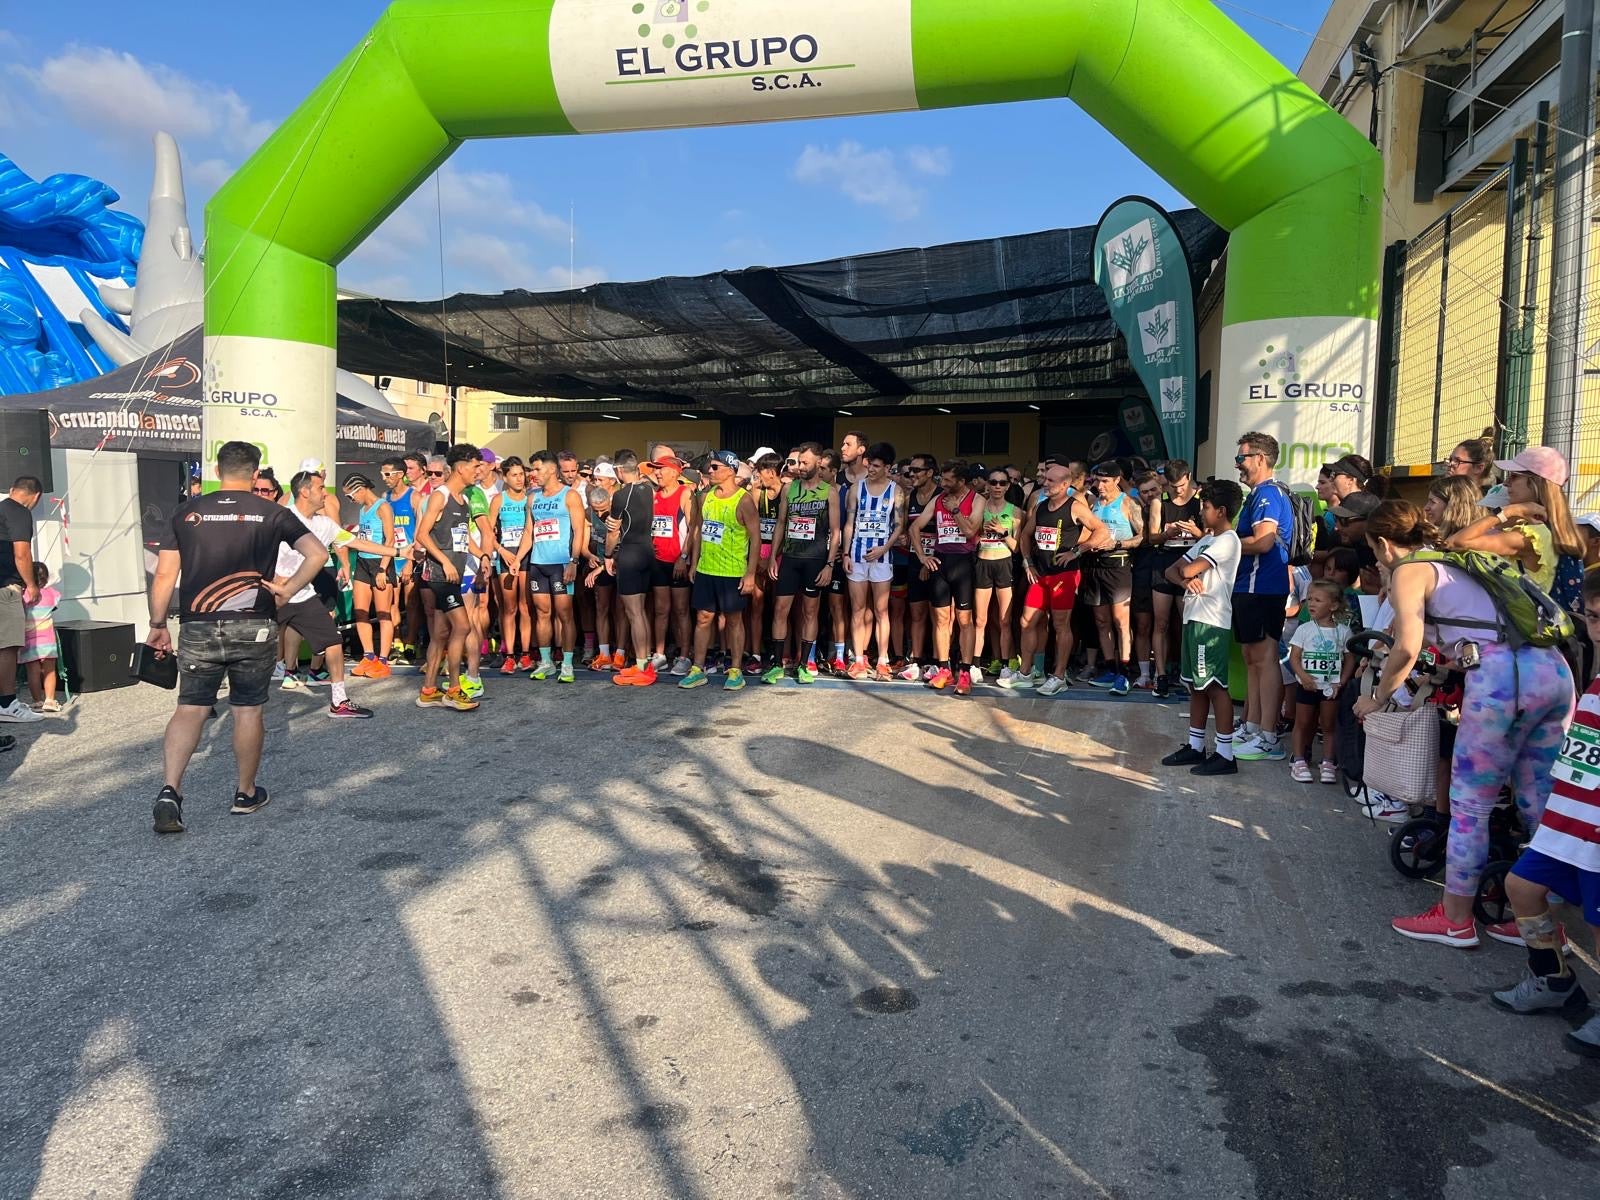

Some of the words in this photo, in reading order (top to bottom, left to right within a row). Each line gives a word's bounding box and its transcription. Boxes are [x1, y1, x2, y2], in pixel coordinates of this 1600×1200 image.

[616, 47, 666, 76] EL
[675, 34, 819, 72] GRUPO
[751, 73, 823, 92] S.C.A.
[1249, 385, 1278, 399] EL
[1284, 383, 1363, 399] GRUPO
[211, 391, 278, 406] GRUPO
[240, 408, 278, 418] S.C.A.
[1329, 402, 1362, 413] S.C.A.
[59, 408, 201, 431] cruzandolameta
[533, 500, 559, 511] nerja
[537, 524, 553, 533] 833
[653, 521, 667, 529] 213
[704, 525, 719, 534] 212
[793, 522, 810, 531] 726
[864, 522, 881, 530] 142
[943, 527, 960, 535] 694
[1304, 659, 1337, 671] 1183
